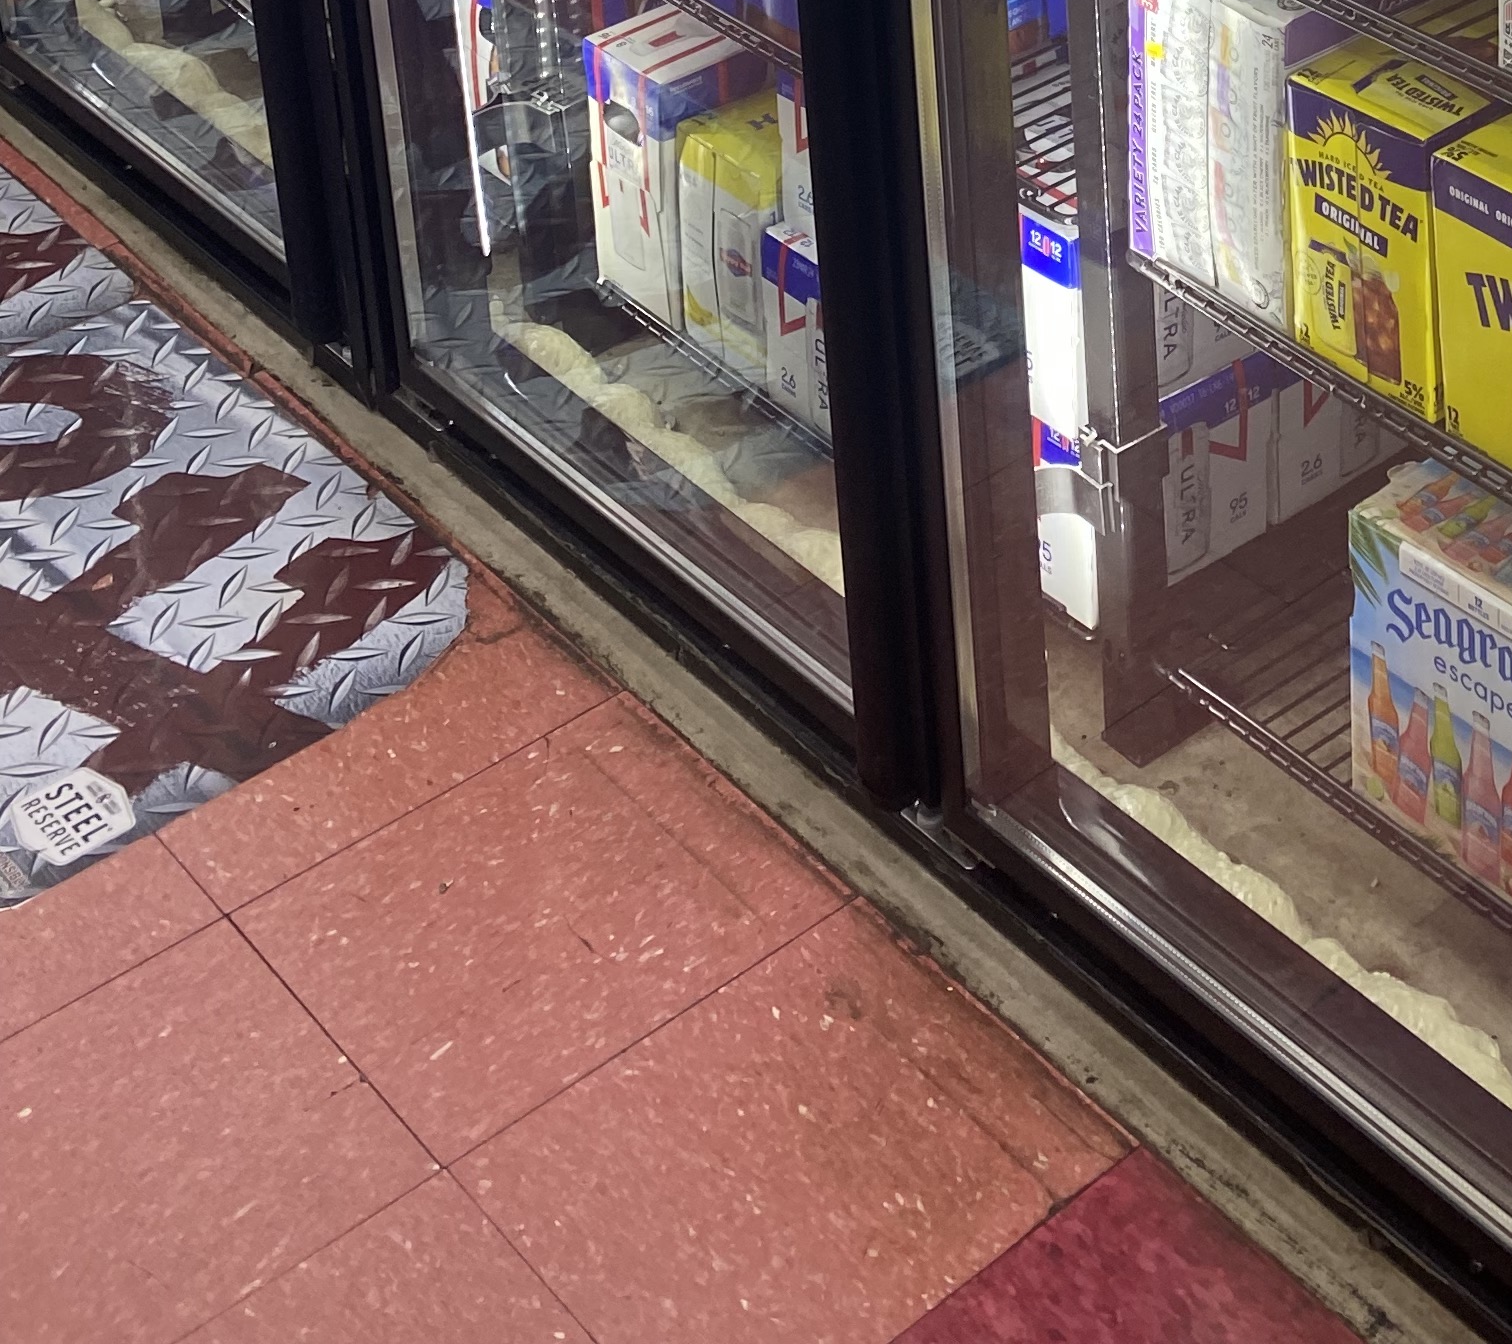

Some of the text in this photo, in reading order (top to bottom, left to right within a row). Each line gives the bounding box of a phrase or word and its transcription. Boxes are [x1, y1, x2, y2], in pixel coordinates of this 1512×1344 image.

[1290, 158, 1420, 243] TWISTED TEA
[1321, 202, 1381, 251] ORIGINAL
[1448, 185, 1490, 215] ORIGINAL
[1230, 492, 1248, 512] 95
[21, 797, 80, 856] RESERVE
[45, 783, 109, 844] STEEL
